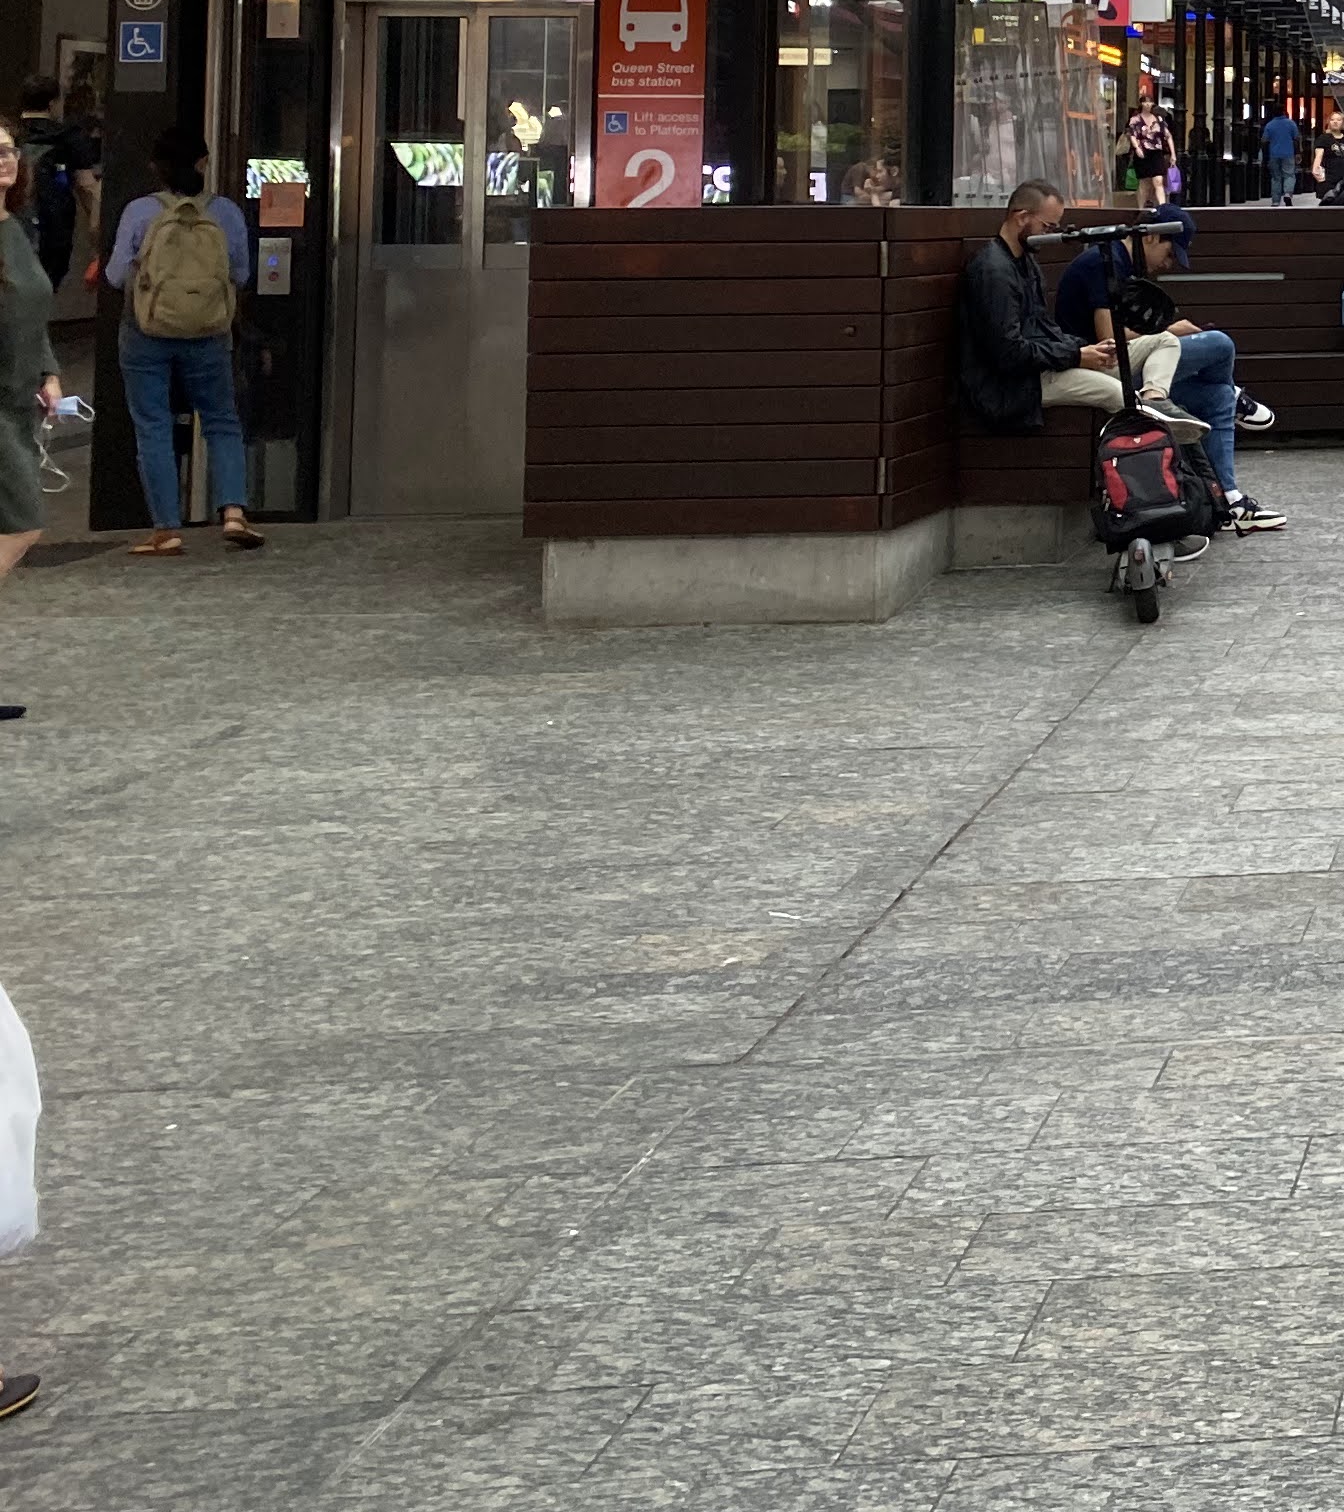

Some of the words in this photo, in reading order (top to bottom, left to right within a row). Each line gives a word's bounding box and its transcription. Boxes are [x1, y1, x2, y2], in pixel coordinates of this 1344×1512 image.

[611, 62, 653, 75] Queen
[656, 62, 695, 74] Street
[611, 76, 635, 88] bus
[637, 76, 681, 88] station
[634, 111, 653, 123] Lift
[657, 114, 699, 123] access
[634, 125, 647, 136] to
[650, 124, 699, 136] Platform
[624, 148, 676, 208] 2
